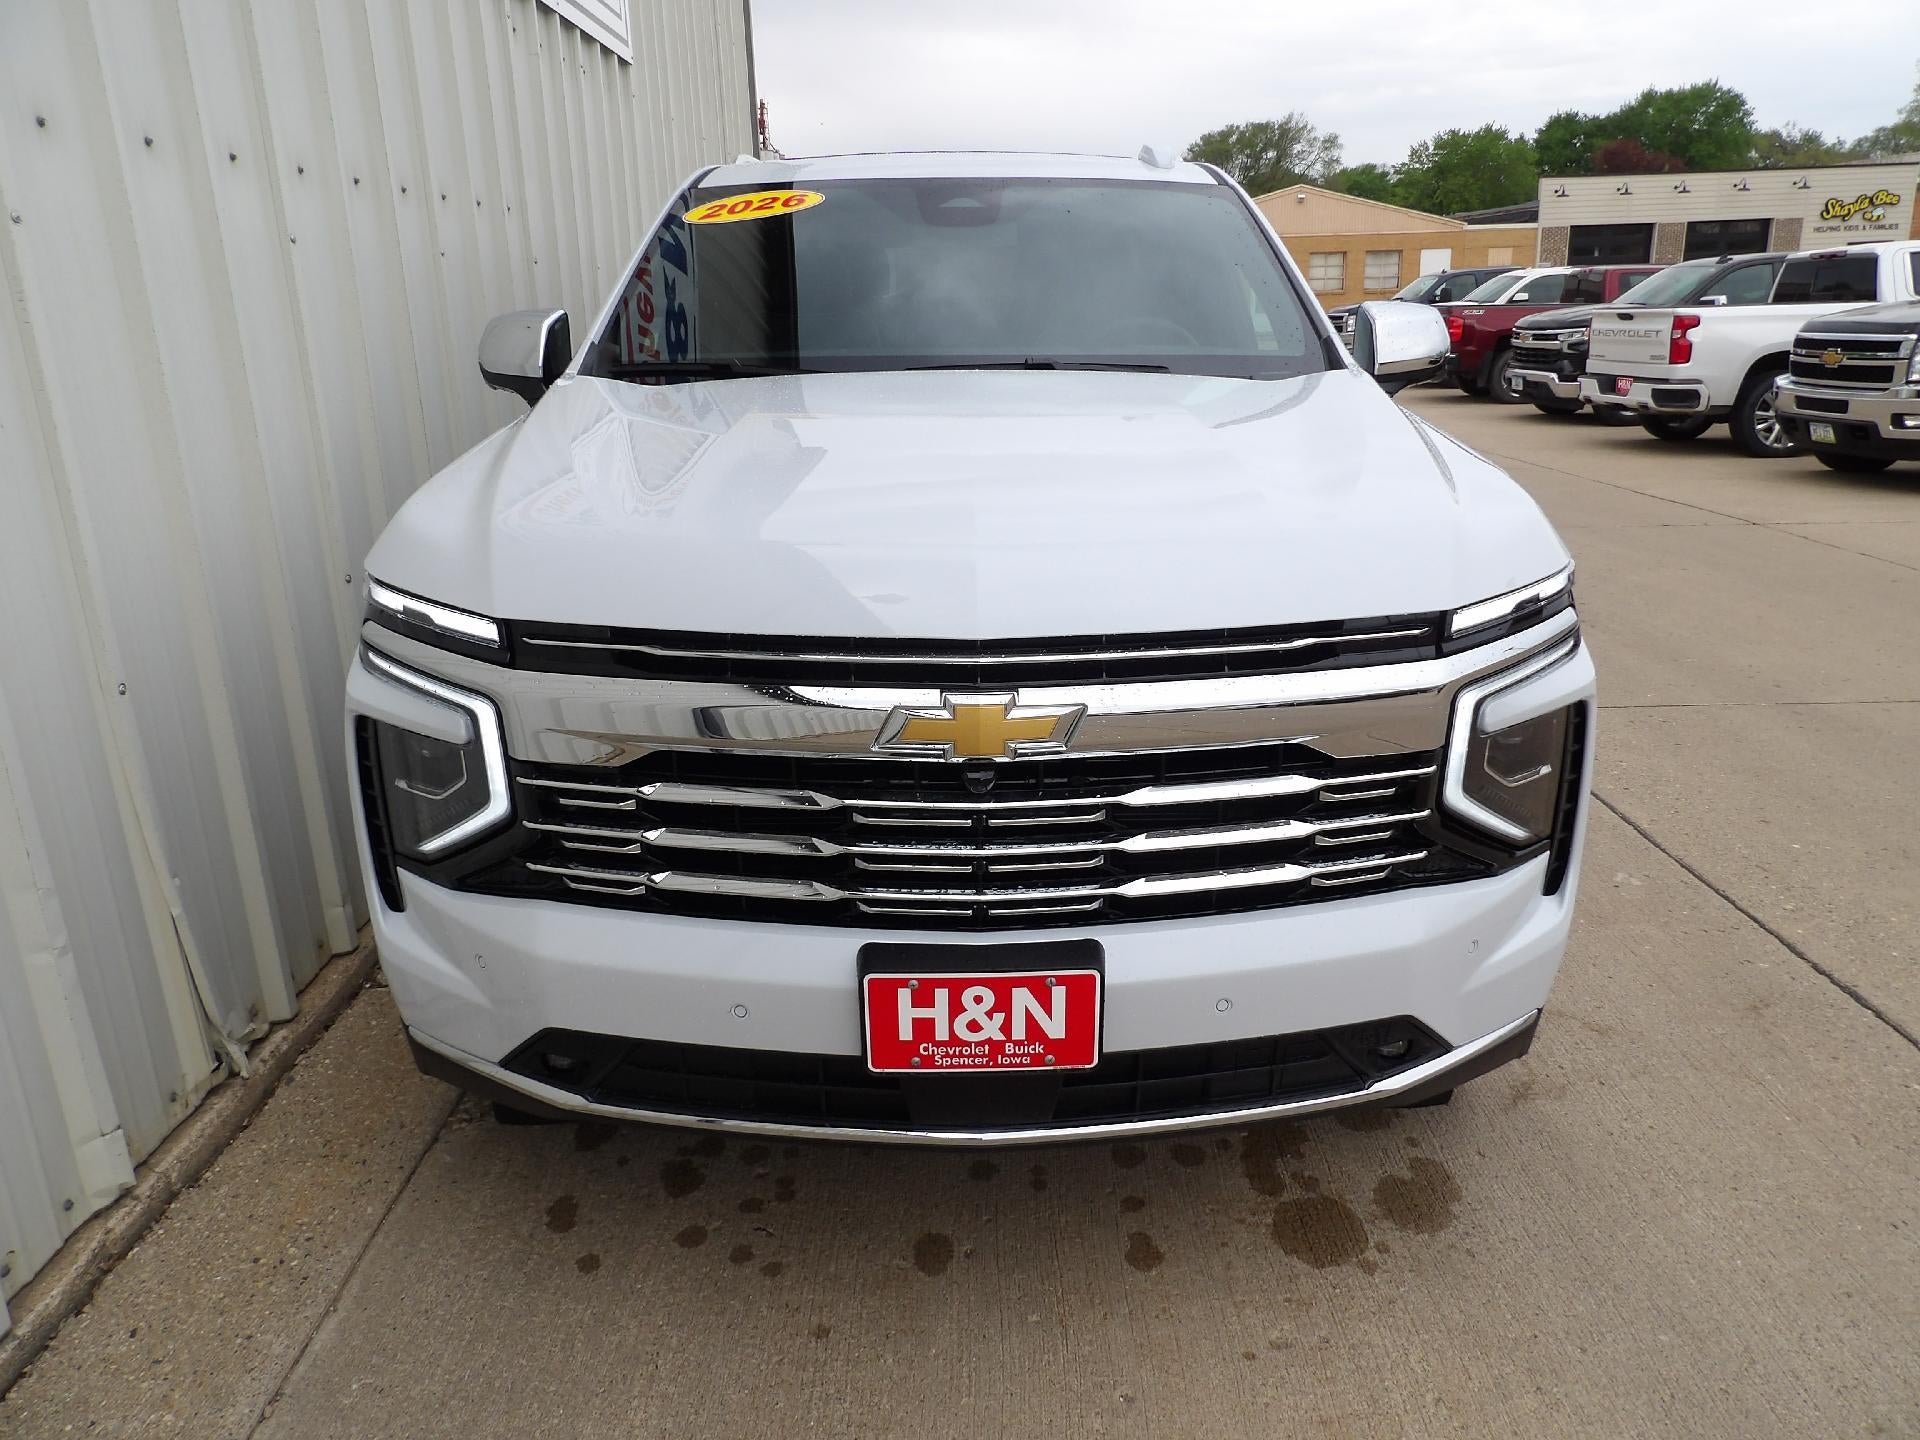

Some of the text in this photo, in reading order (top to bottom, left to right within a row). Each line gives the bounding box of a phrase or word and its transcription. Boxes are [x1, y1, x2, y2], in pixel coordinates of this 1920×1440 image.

[698, 194, 808, 220] 2026
[1821, 189, 1901, 222] Shayla Bee
[1813, 225, 1841, 233] HELPING
[1843, 224, 1860, 232] KIDS
[1869, 223, 1899, 231] FAMILIES
[1592, 329, 1663, 338] CHEVROLET
[1618, 379, 1631, 390] H&N
[897, 985, 1067, 1042] H&N
[919, 1041, 1045, 1056] Chevrolet Buick
[934, 1054, 1031, 1067] Spencer, Iowa
